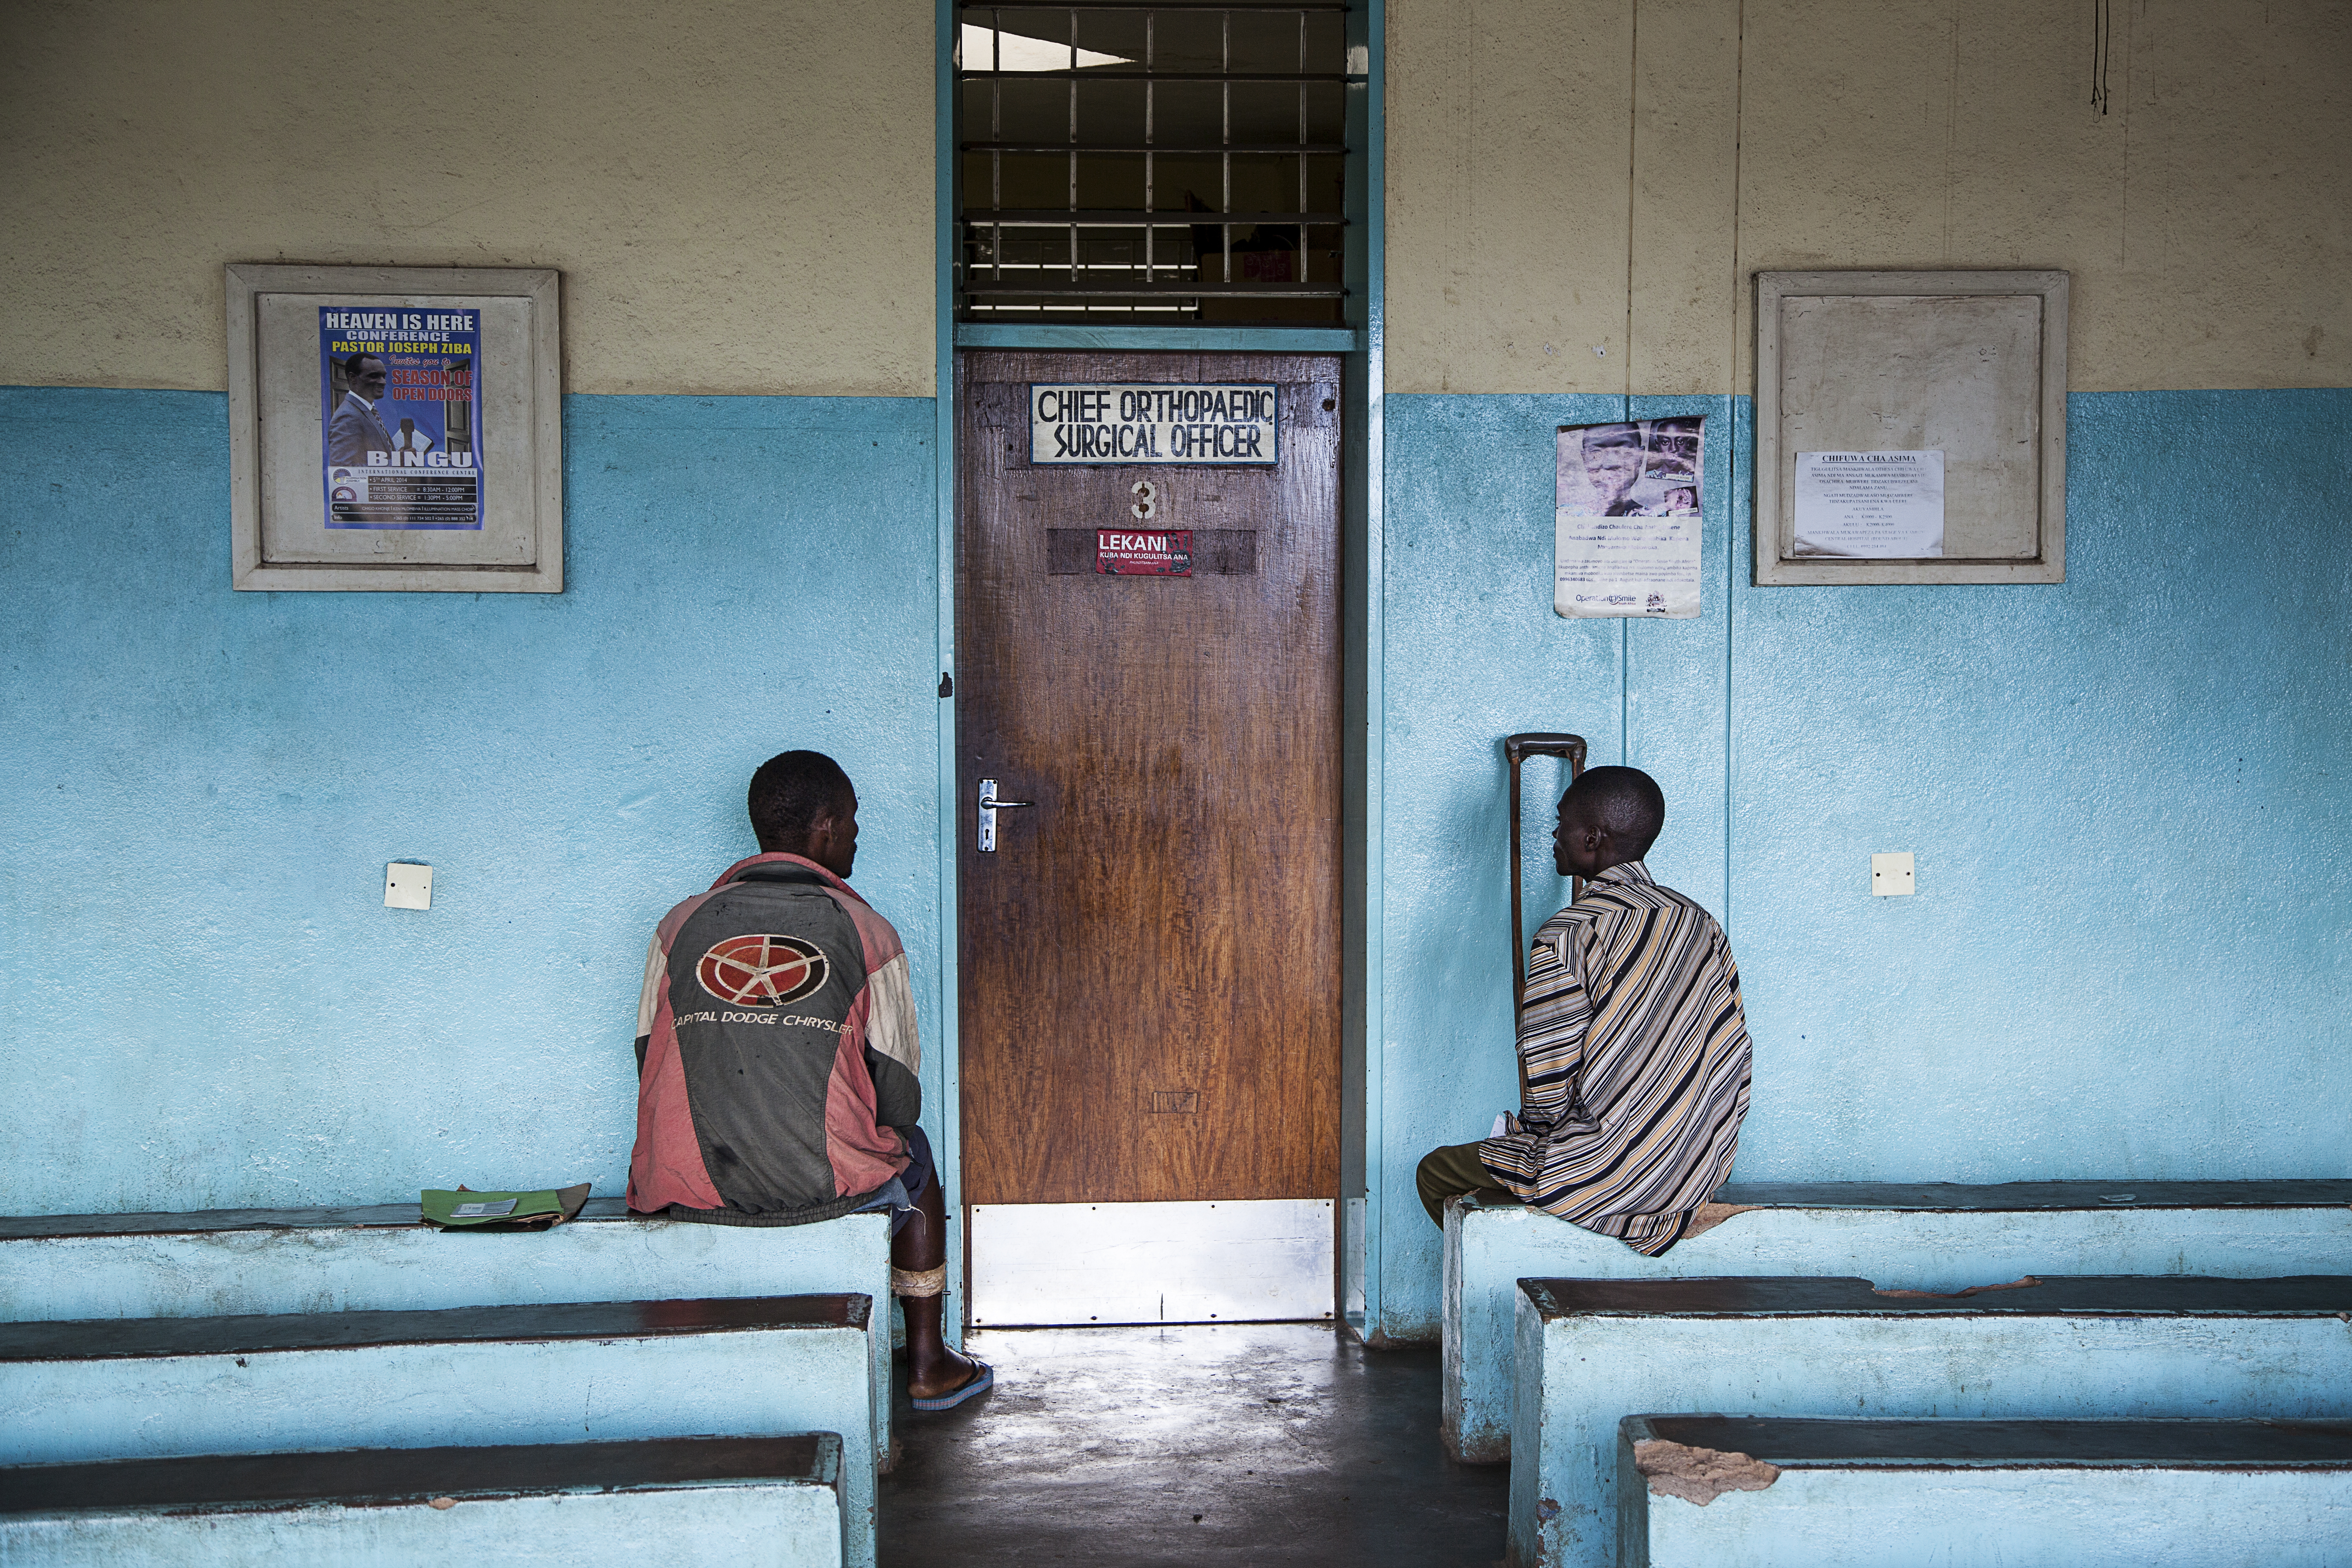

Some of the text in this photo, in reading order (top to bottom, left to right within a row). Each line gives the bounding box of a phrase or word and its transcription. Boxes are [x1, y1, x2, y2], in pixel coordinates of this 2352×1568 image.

[327, 313, 473, 330] HEAVEN IS HERE
[347, 330, 450, 342] CONFERENCE
[332, 341, 472, 354] PASTOR JOSEPH ZIBA
[389, 355, 420, 365] Invites
[423, 358, 438, 368] you
[392, 369, 472, 386] SEASON OF
[393, 387, 472, 401] OPEN DOORS
[1038, 389, 1273, 423] CHIEF ORTHOPAEDIC
[1054, 424, 1262, 458] SURGICAL OFFICER
[367, 451, 472, 467] BINGU
[1131, 481, 1156, 519] 3
[1099, 534, 1166, 553] LEKANI
[1576, 594, 1608, 603] Operation
[671, 1011, 853, 1036] CAPITAL DODGE CHRYSLER
